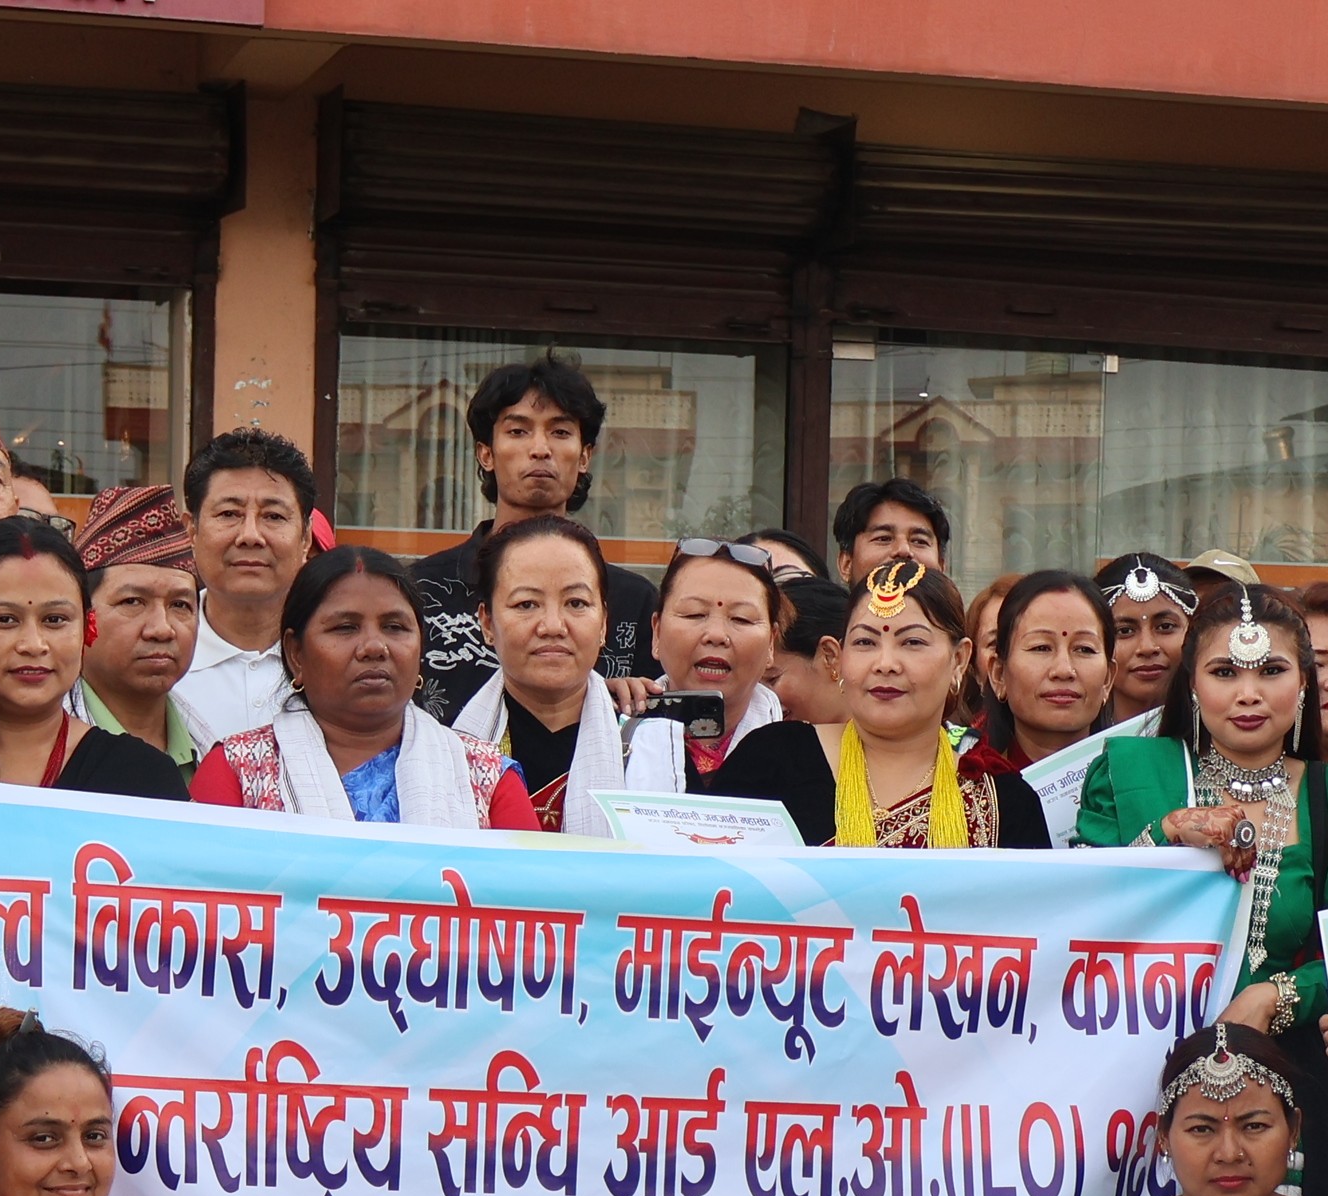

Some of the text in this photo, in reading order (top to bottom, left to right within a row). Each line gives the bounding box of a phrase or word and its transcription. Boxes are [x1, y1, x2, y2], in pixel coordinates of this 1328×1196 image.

[1038, 763, 1090, 798] पाल आदिवा
[73, 842, 288, 1010] विकास,
[615, 888, 854, 1065] माईन्यूट
[871, 894, 1039, 1044] लेखन,
